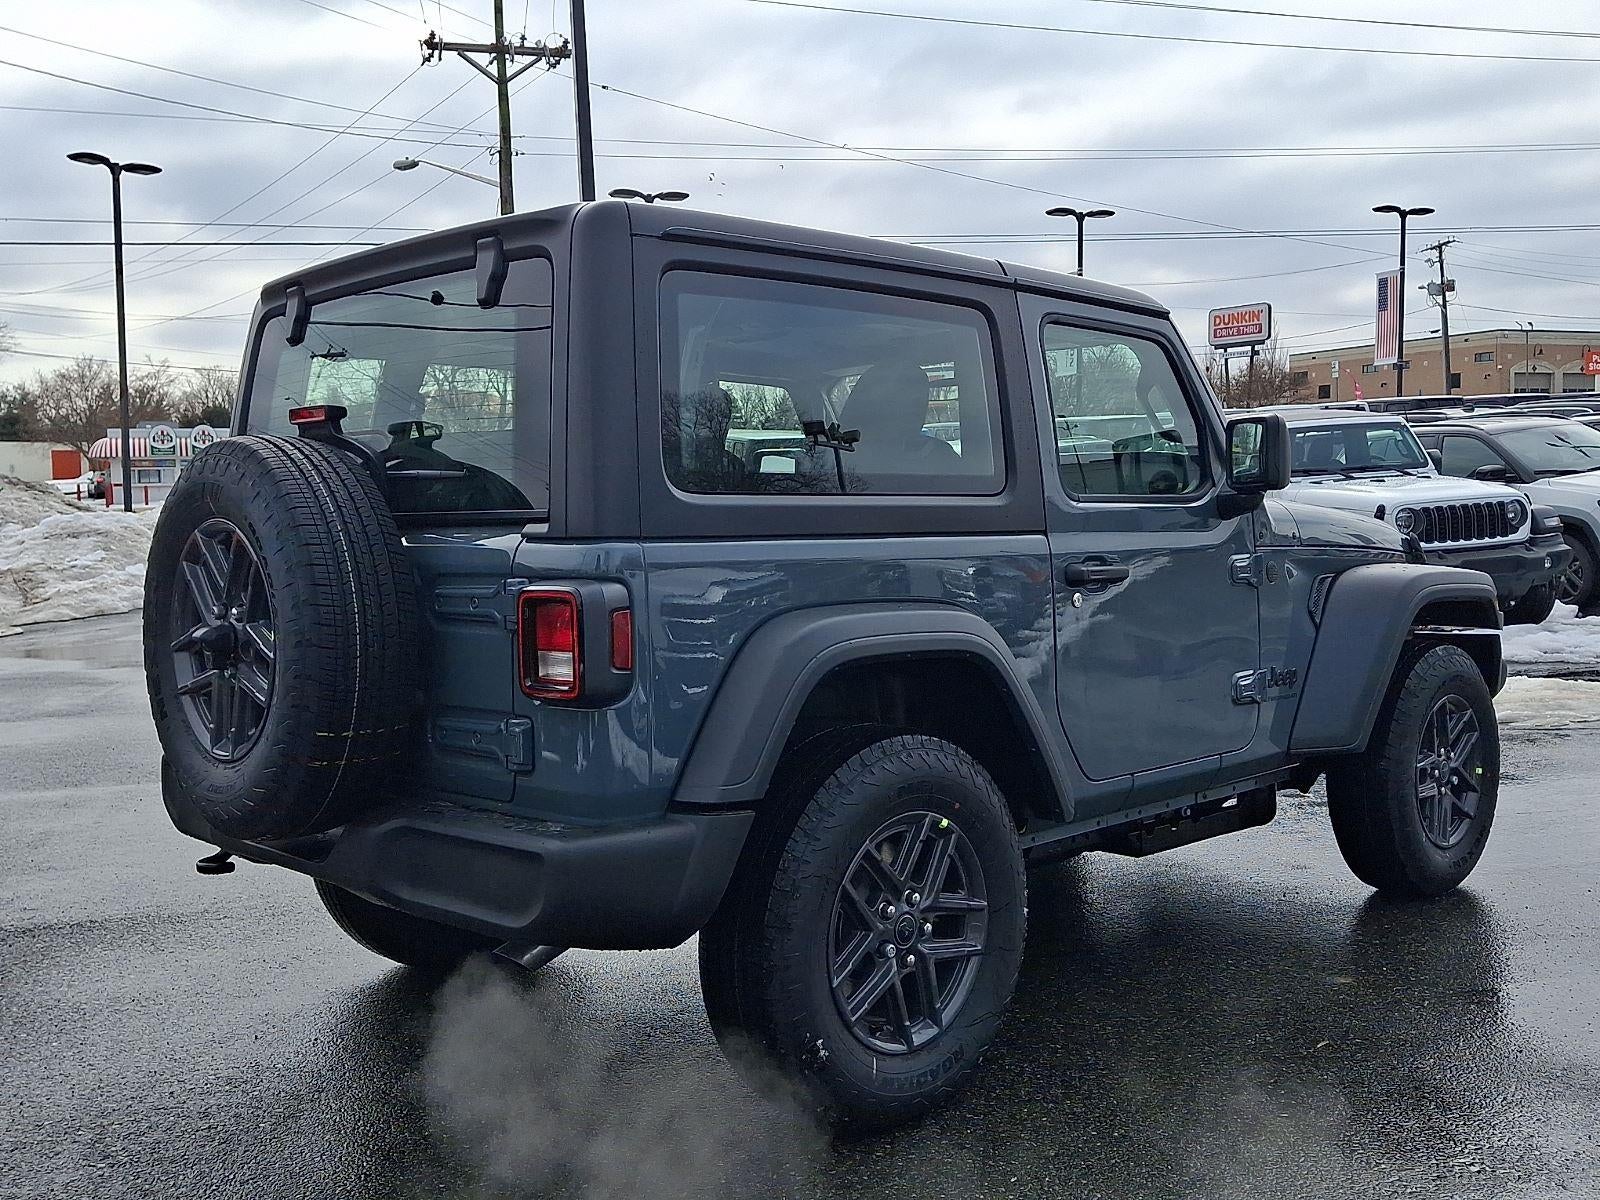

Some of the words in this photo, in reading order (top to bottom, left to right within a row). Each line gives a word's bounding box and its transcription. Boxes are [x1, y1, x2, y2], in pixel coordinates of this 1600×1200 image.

[1213, 308, 1264, 327] DUNKIN'
[1216, 327, 1239, 338] DRIVE
[1239, 324, 1260, 335] THRU
[1266, 665, 1298, 690] Jeep
